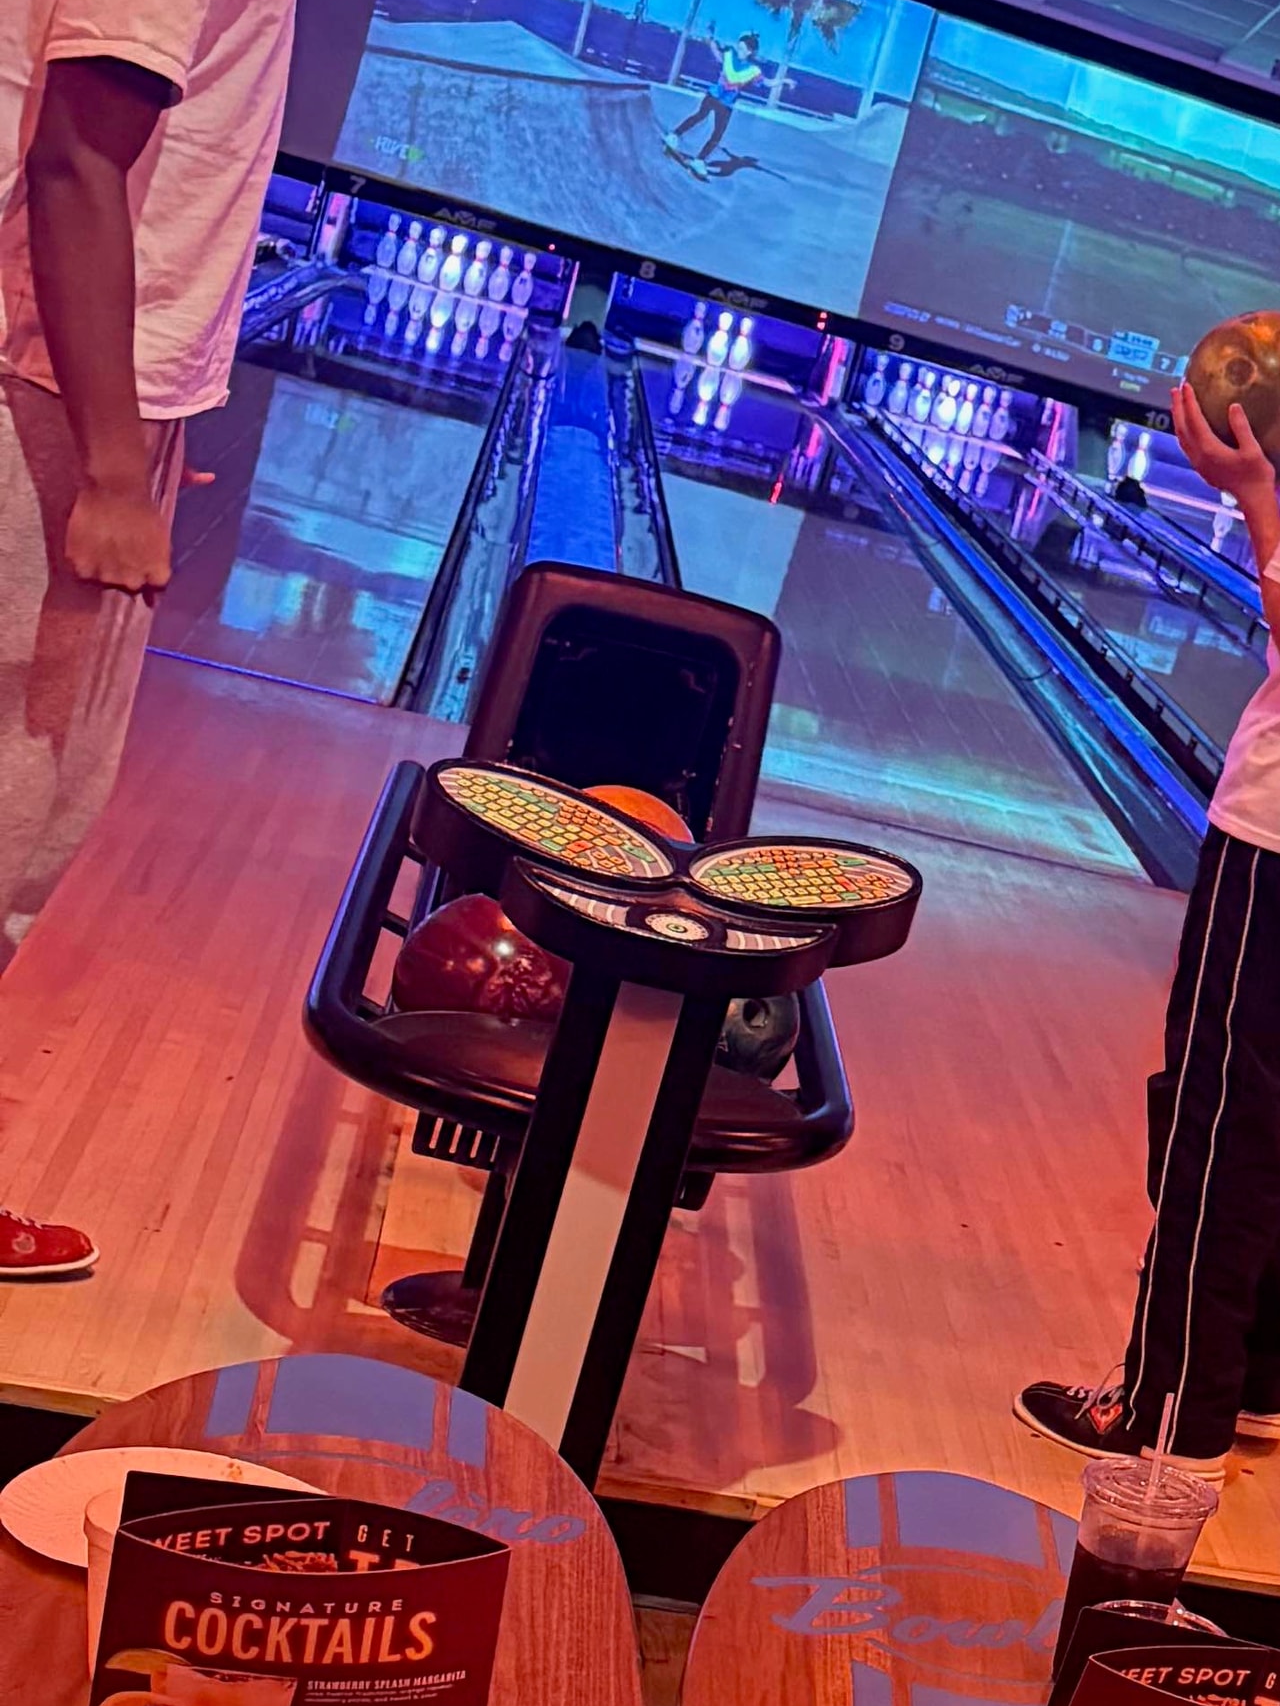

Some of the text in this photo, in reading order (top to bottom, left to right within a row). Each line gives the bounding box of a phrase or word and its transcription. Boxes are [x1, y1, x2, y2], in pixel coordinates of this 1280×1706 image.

[349, 174, 366, 193] 7
[638, 261, 655, 279] 8
[889, 334, 905, 351] 9
[1145, 411, 1170, 430] 10
[243, 1521, 331, 1545] SPOT
[356, 1523, 416, 1553] GET
[210, 1591, 403, 1615] SIGNATURE
[164, 1600, 438, 1665] COCKTAILS
[1178, 1667, 1251, 1686] SPOT
